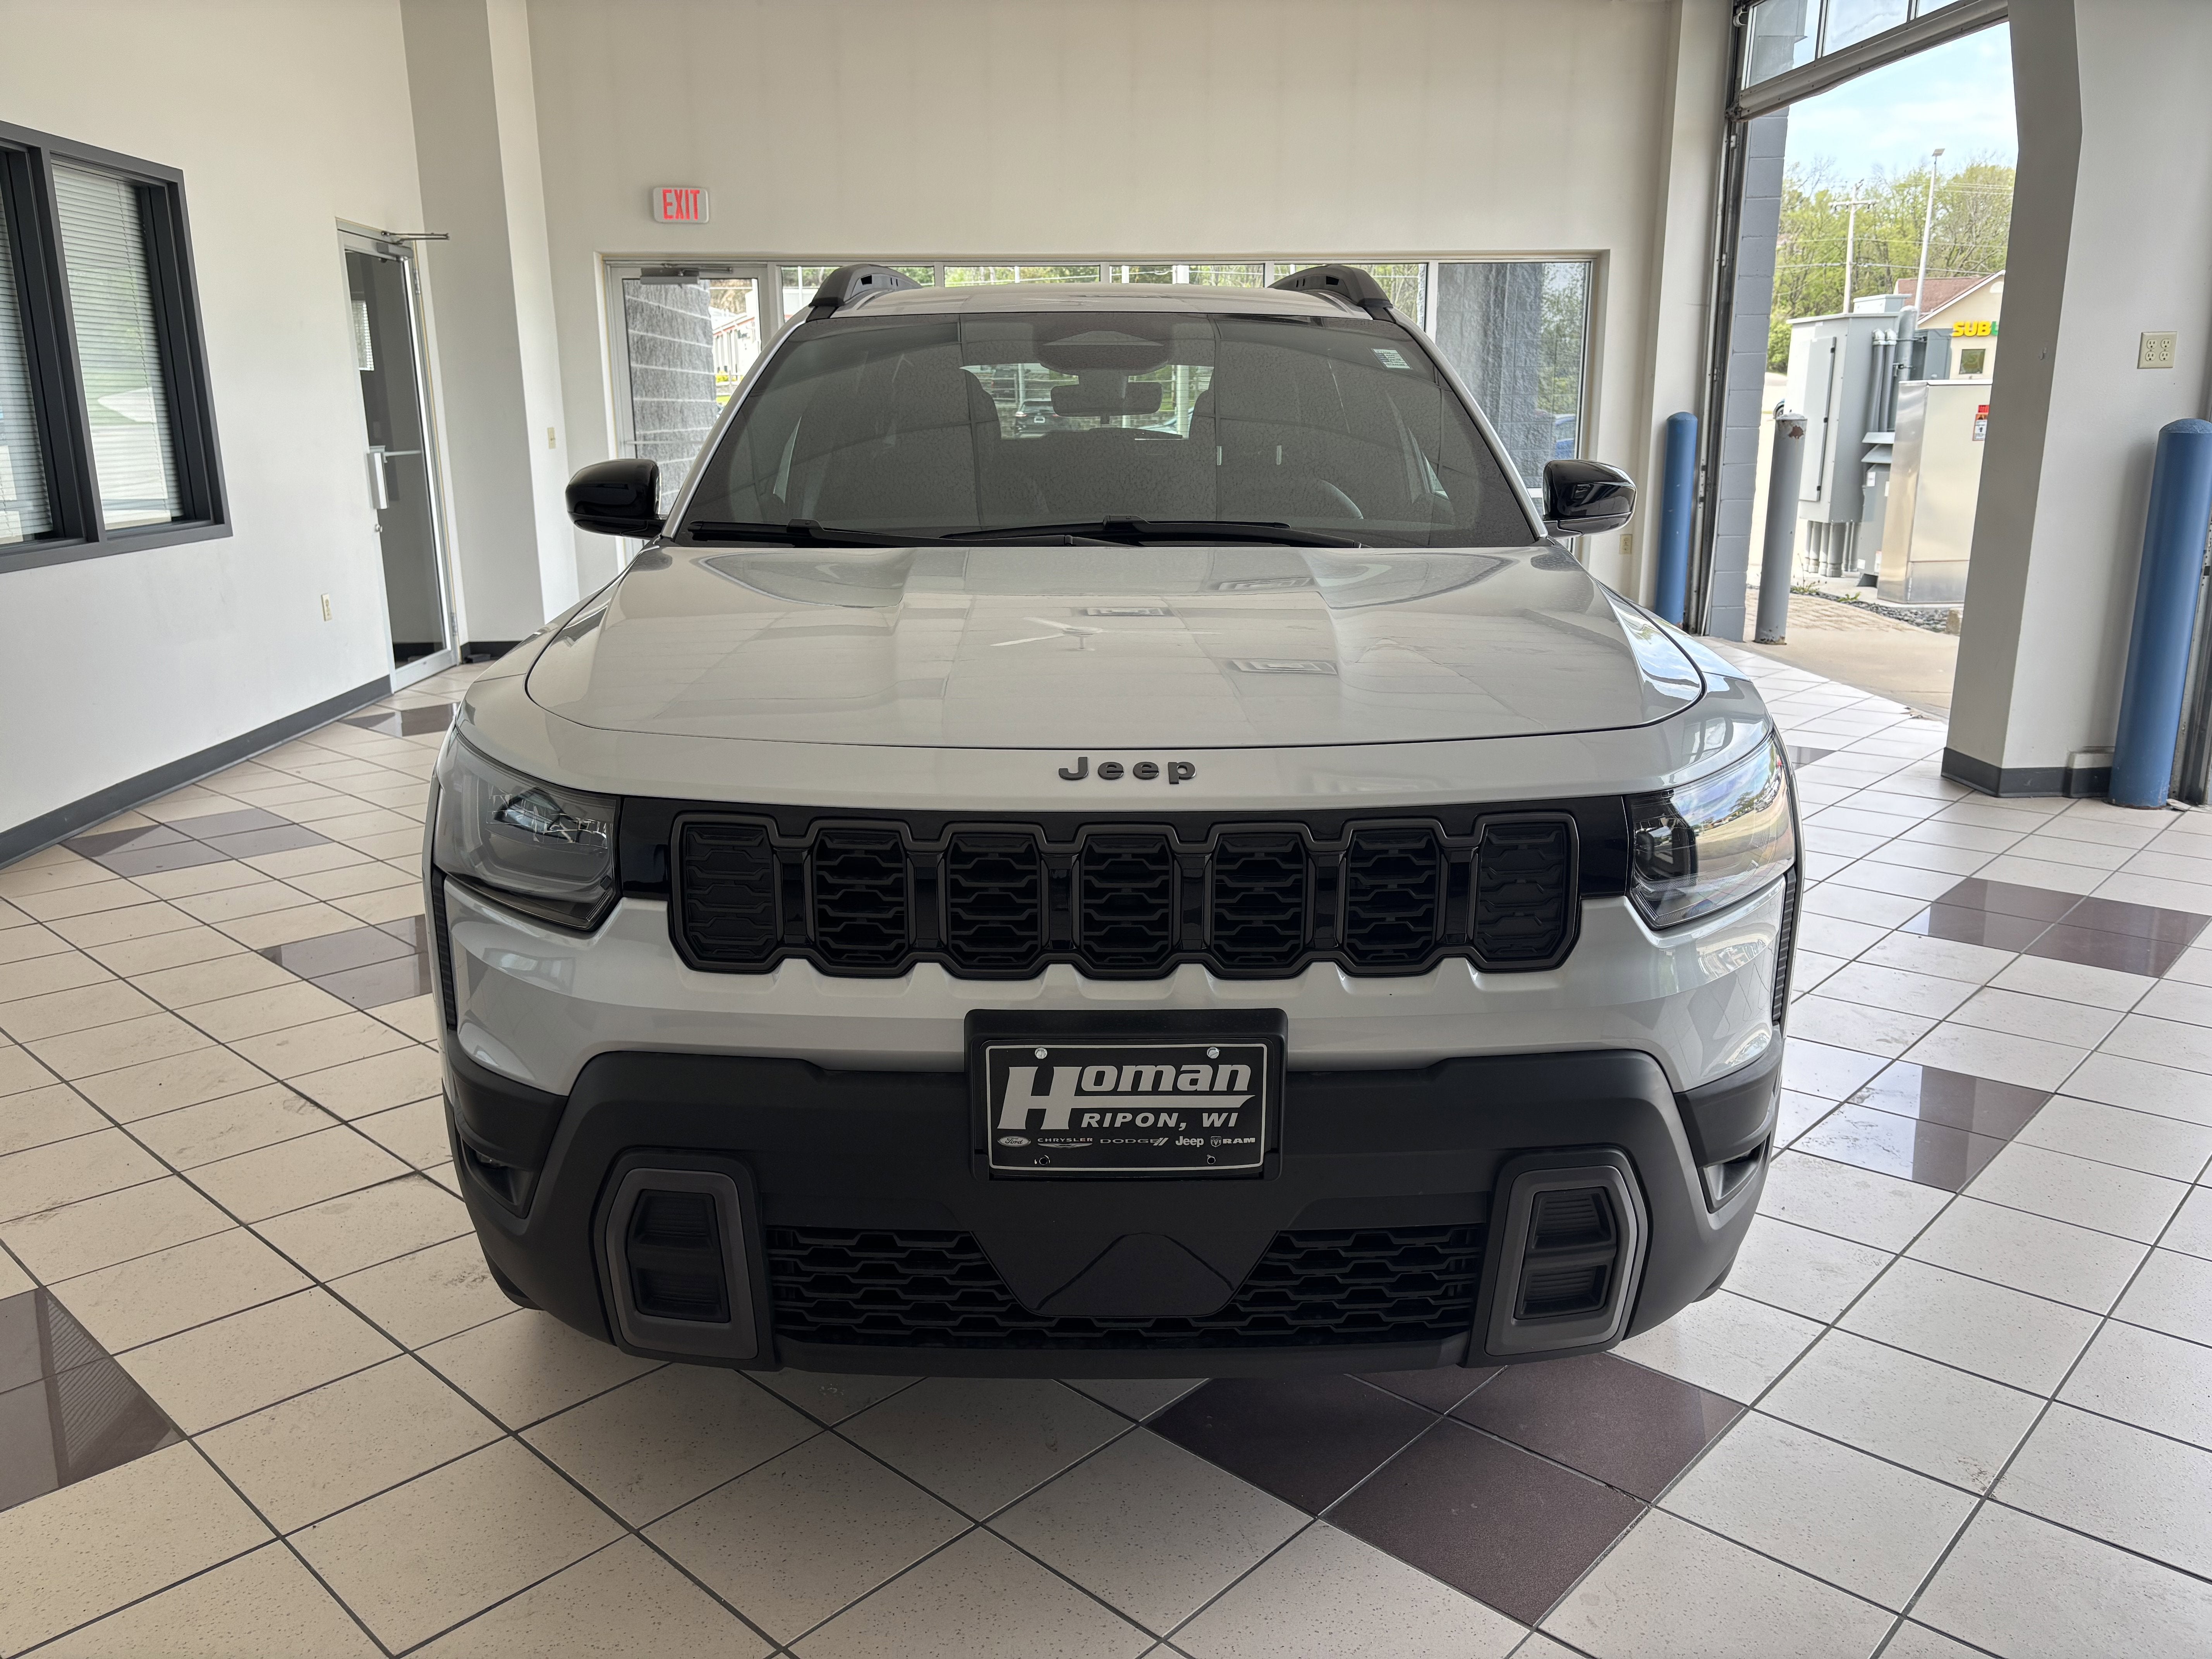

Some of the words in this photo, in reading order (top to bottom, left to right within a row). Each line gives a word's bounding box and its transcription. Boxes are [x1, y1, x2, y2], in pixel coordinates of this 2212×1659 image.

[662, 189, 700, 220] EXIT
[1058, 757, 1196, 784] Jeep
[997, 1064, 1255, 1130] Homan
[1081, 1113, 1187, 1130] RIPON,
[1202, 1113, 1238, 1128] WI
[1175, 1135, 1204, 1147] Jeep
